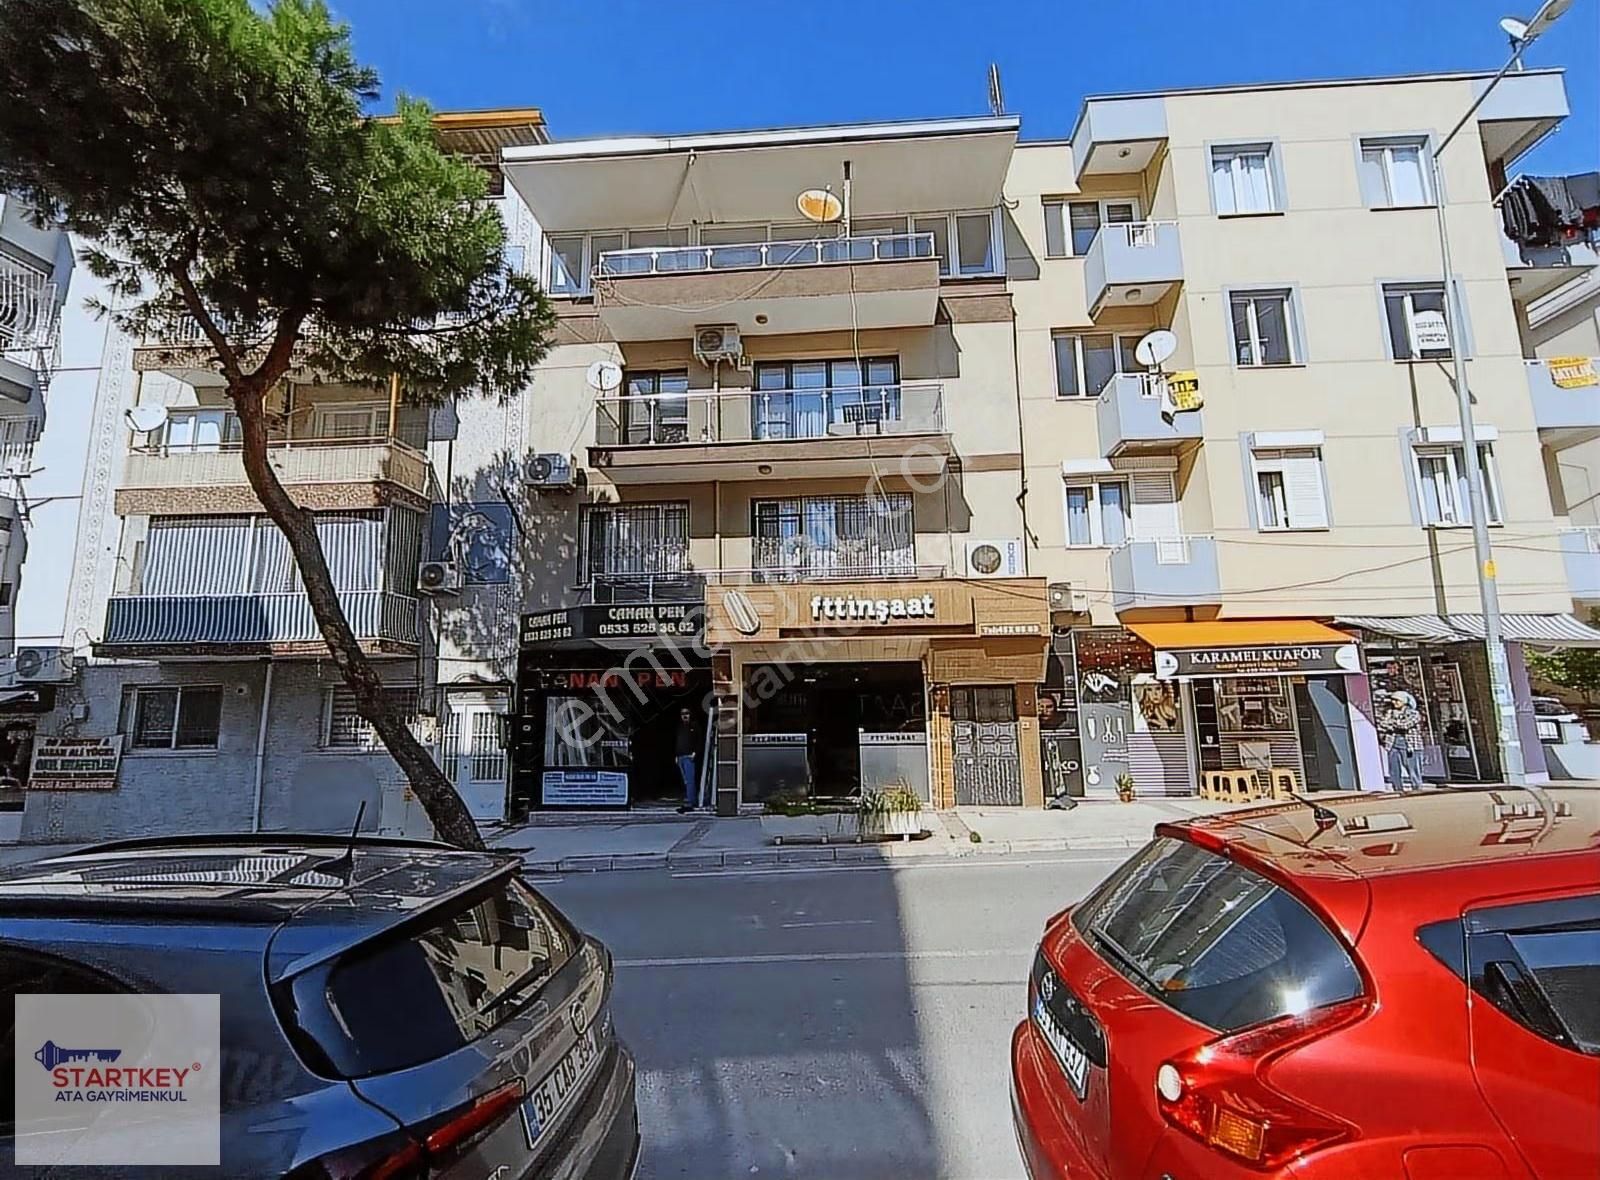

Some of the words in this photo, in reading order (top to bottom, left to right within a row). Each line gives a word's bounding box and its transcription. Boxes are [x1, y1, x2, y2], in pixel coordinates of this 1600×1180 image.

[659, 606, 685, 619] PEN
[811, 594, 935, 624] fttinşaat
[599, 624, 629, 634] 0533
[1190, 649, 1261, 664] KARAMEL
[1264, 648, 1322, 661] KUAFÖR
[534, 1083, 553, 1125] 35
[554, 1055, 577, 1099] CAB
